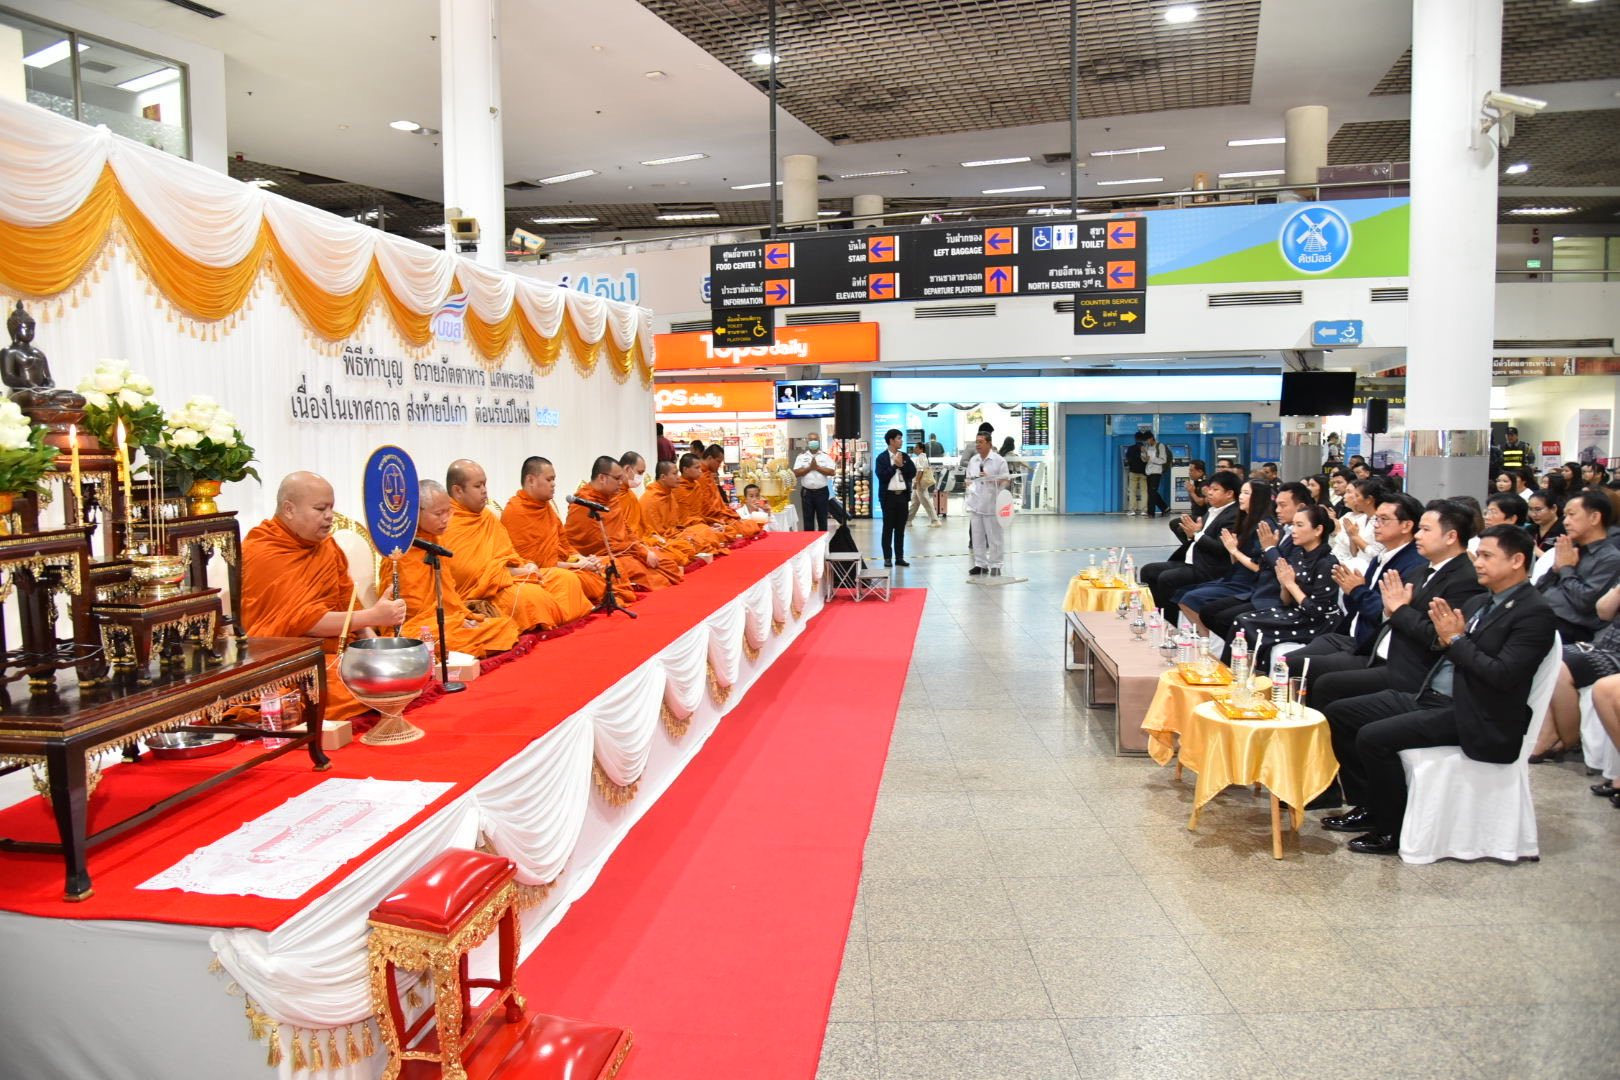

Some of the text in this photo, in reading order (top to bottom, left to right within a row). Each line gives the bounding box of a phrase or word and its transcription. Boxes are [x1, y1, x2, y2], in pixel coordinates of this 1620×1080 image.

[946, 233, 982, 243] รับฝากของ
[1090, 227, 1105, 239] สุขา
[848, 239, 866, 251] บันได
[1081, 240, 1104, 249] TOILET
[723, 247, 756, 262] ศูนย์อาหาร
[951, 247, 982, 255] BAGGAGE
[1298, 253, 1332, 264] ดัชมิลล์
[716, 263, 732, 271] FOOD
[733, 262, 756, 270] CENTER
[1049, 265, 1083, 276] สายอีสาน
[1085, 261, 1096, 275] ชั้น
[929, 273, 982, 282] ชานชาลาขาออก
[721, 282, 764, 294] ประชาสัมพันธ์
[1051, 281, 1080, 289] EASTERN
[723, 298, 763, 306] INFORMATION
[769, 339, 808, 357] daily
[343, 346, 403, 388] พิธีทำบุญ
[414, 357, 485, 386] ถวายภัตตาหาร
[291, 374, 400, 421] เนื่องในเทศกาล
[406, 394, 467, 422] ส่งท้ายปีเก่า
[475, 397, 530, 424] ต้อนรับปีใหม่
[688, 393, 723, 408] daily
